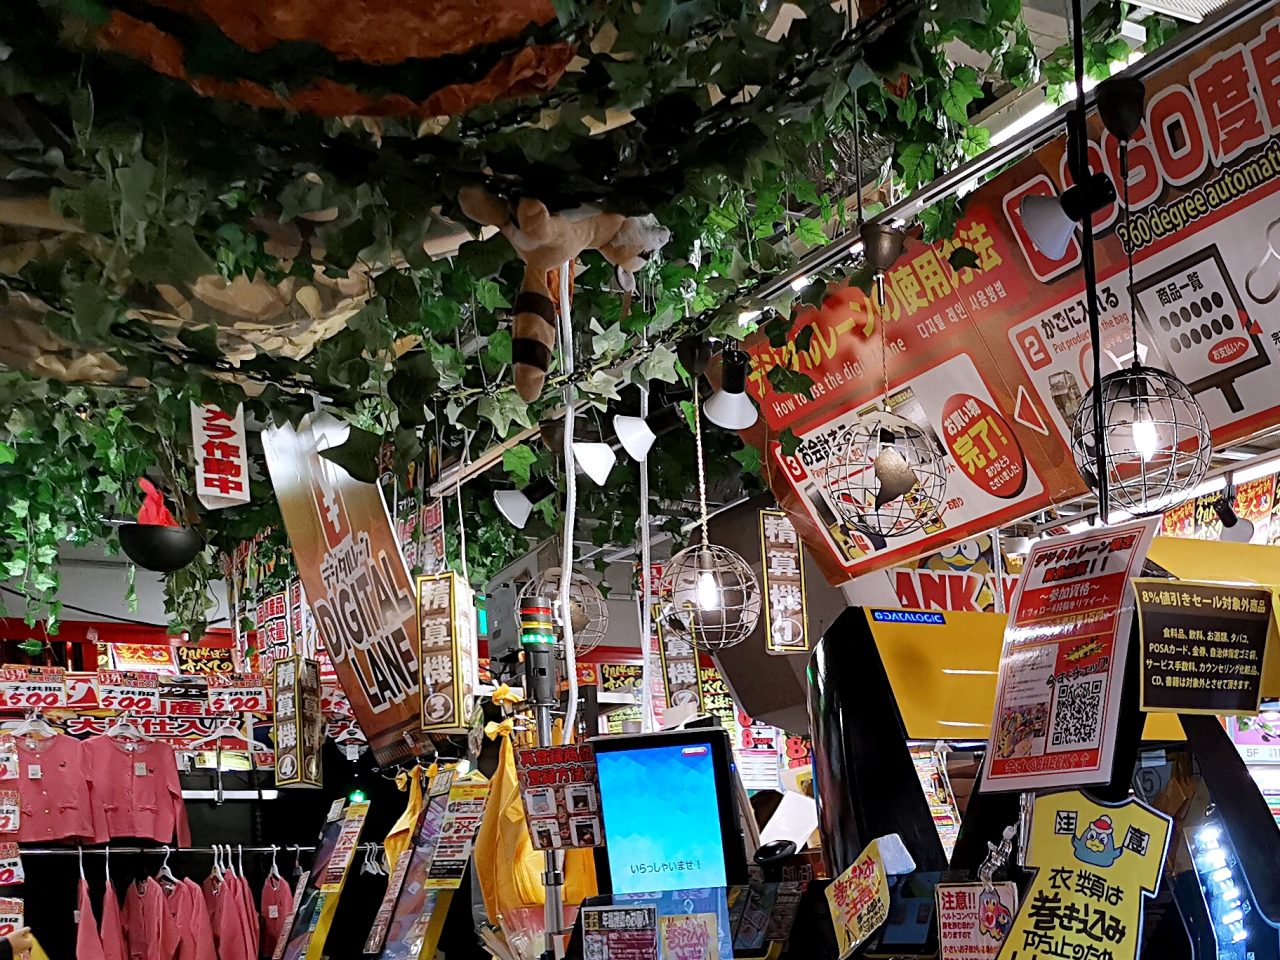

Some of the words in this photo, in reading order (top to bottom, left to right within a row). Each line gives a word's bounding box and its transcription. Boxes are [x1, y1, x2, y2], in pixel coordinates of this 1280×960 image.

[1149, 187, 1205, 238] degree
[1155, 270, 1206, 305] 商品一覧
[1024, 336, 1044, 362] 2
[772, 396, 795, 418] How
[824, 366, 845, 394] the
[944, 398, 983, 436] お買い物
[952, 415, 1009, 476] 完了！
[786, 455, 801, 477] 3
[314, 550, 416, 664] DIGITAL
[1141, 590, 1267, 614] 8%値引きセール対象外商品
[883, 612, 943, 624] DATALOGIC
[352, 624, 421, 714] LANE
[8, 692, 60, 706] 500
[101, 696, 153, 710] 500
[212, 697, 261, 710] 500
[1057, 812, 1077, 834] 注
[630, 859, 702, 875] いらっしゃいませ！
[1048, 866, 1125, 907] 衣類は
[1028, 889, 1127, 945] 巻き込み
